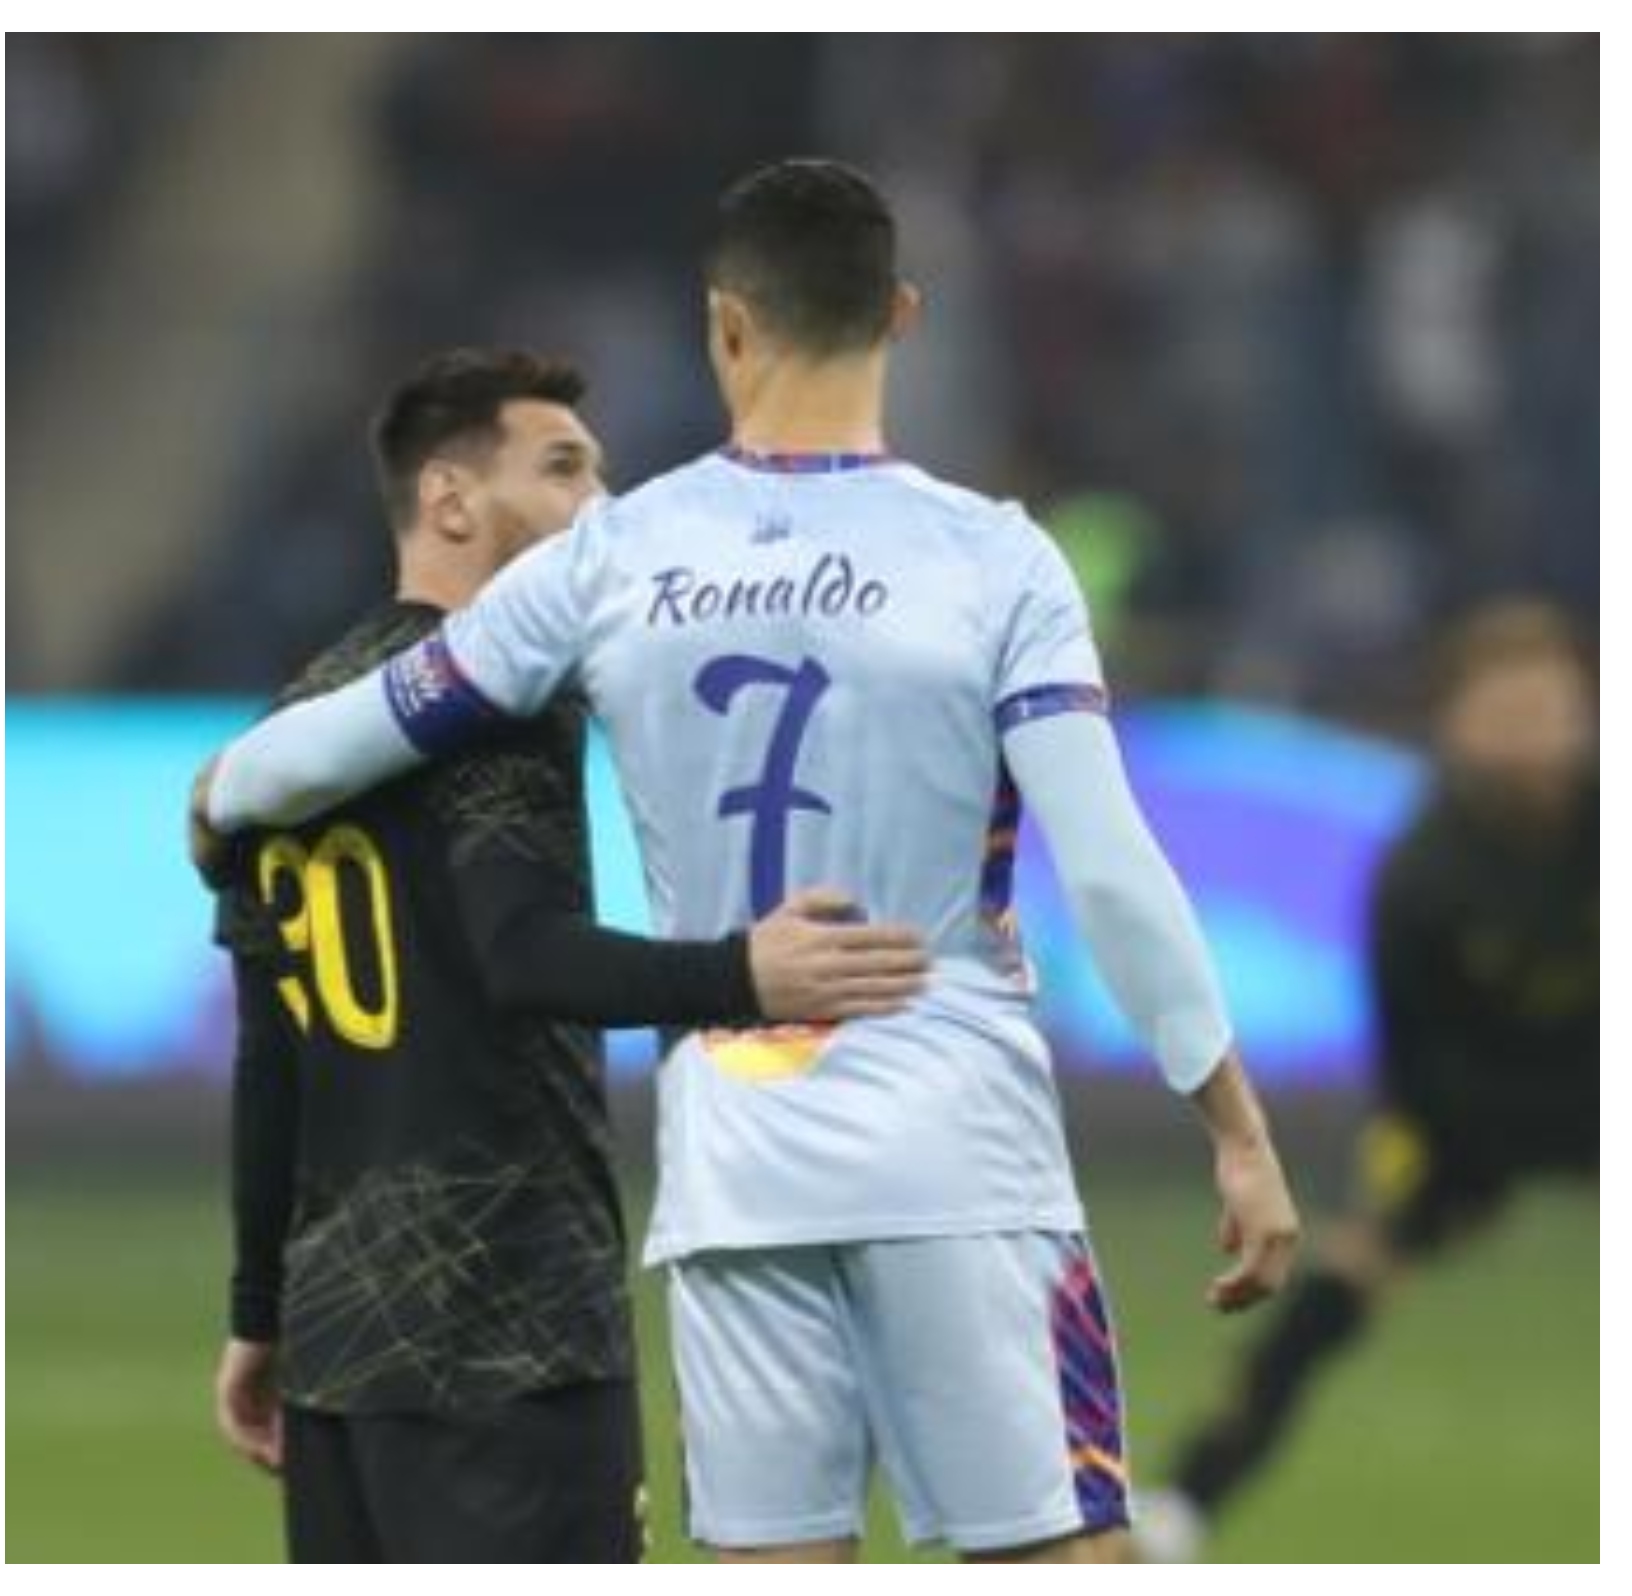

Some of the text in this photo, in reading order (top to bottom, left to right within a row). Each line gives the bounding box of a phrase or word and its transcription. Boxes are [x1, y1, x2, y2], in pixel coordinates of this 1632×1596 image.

[646, 552, 889, 628] Ronaldo
[693, 654, 832, 921] 7
[259, 826, 398, 1048] 30
